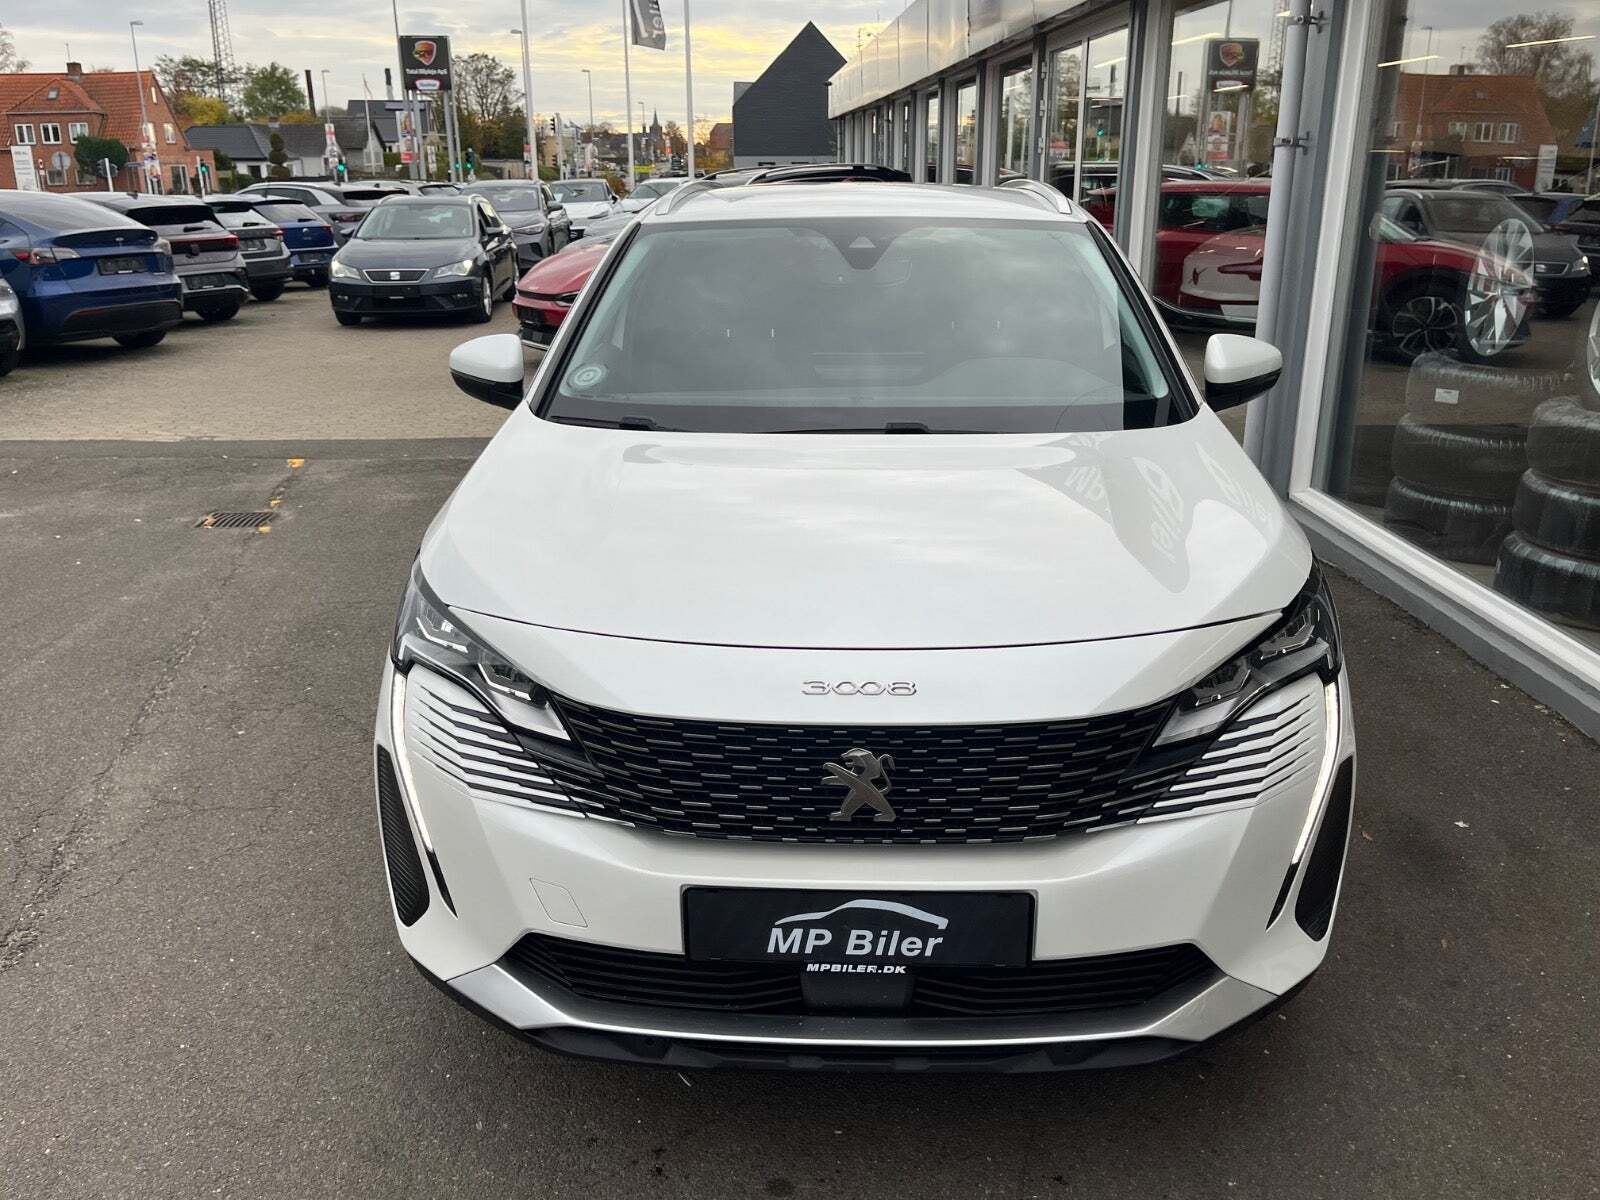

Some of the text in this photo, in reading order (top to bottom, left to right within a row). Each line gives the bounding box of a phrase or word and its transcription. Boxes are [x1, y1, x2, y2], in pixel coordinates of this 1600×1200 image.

[648, 0, 665, 38] iler
[801, 680, 917, 696] 3008
[767, 927, 943, 957] MP Biler
[806, 963, 907, 974] MPBILER.DK
